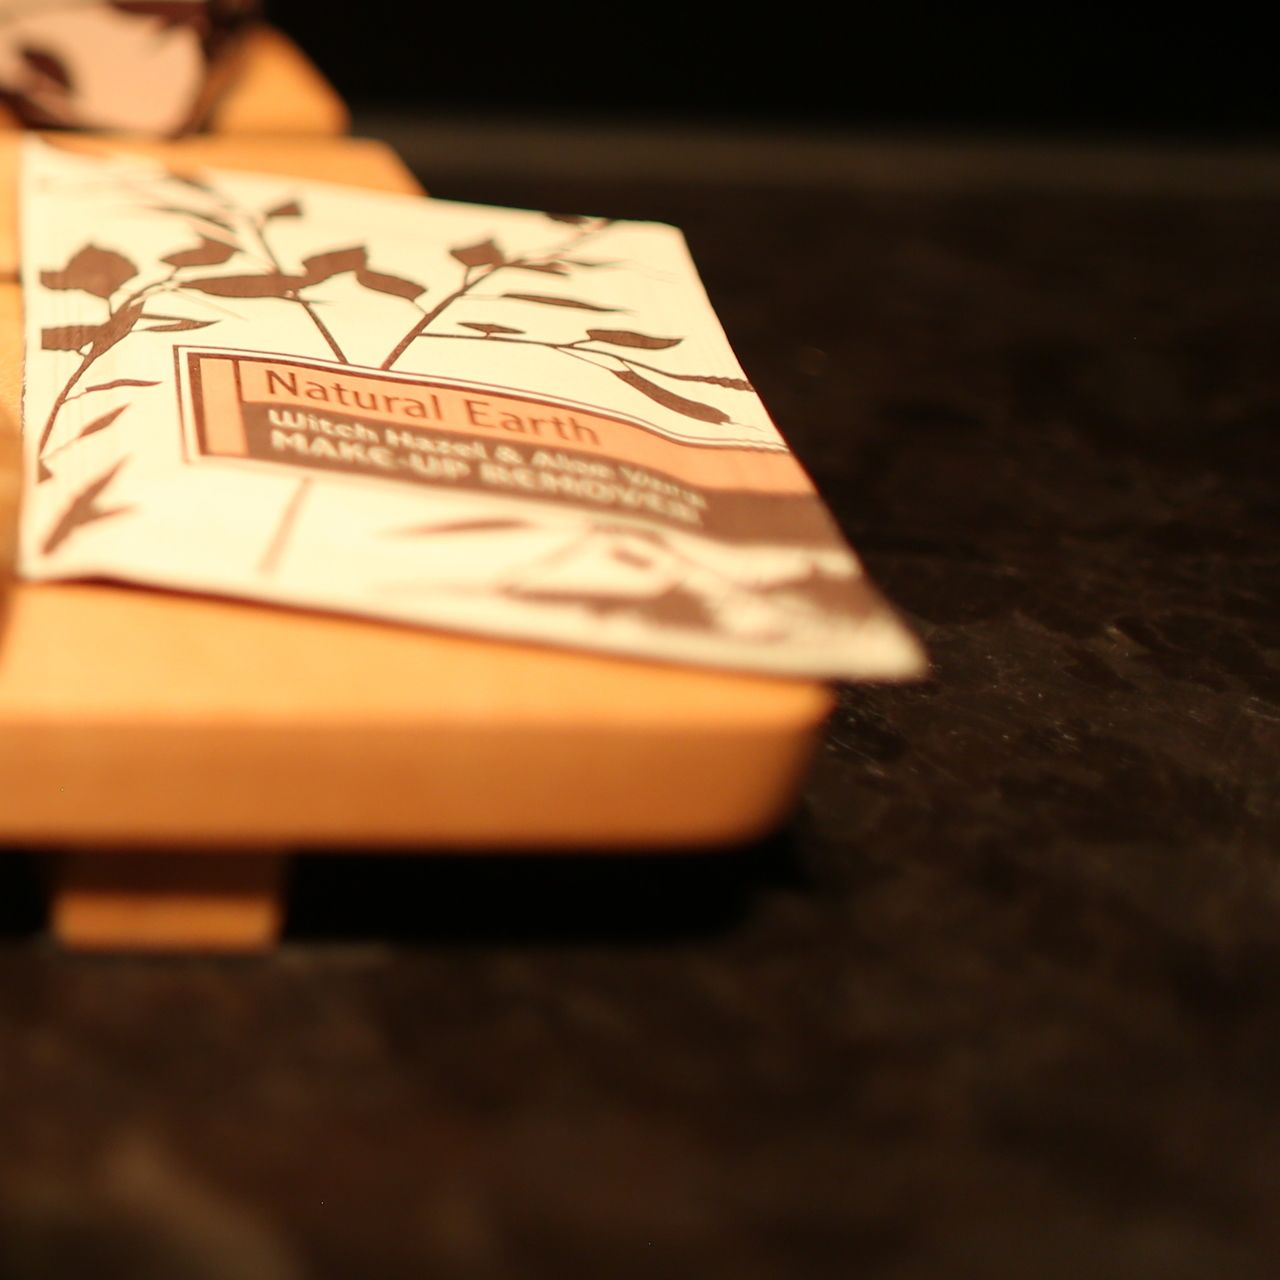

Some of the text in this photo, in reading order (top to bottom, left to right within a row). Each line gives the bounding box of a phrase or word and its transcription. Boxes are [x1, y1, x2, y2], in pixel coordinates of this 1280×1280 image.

[265, 370, 601, 446] Natural Earth
[267, 408, 379, 443] Witch
[385, 426, 488, 460] Hazel
[494, 443, 522, 464] &
[270, 428, 704, 523] MAKE-UP REMOVER
